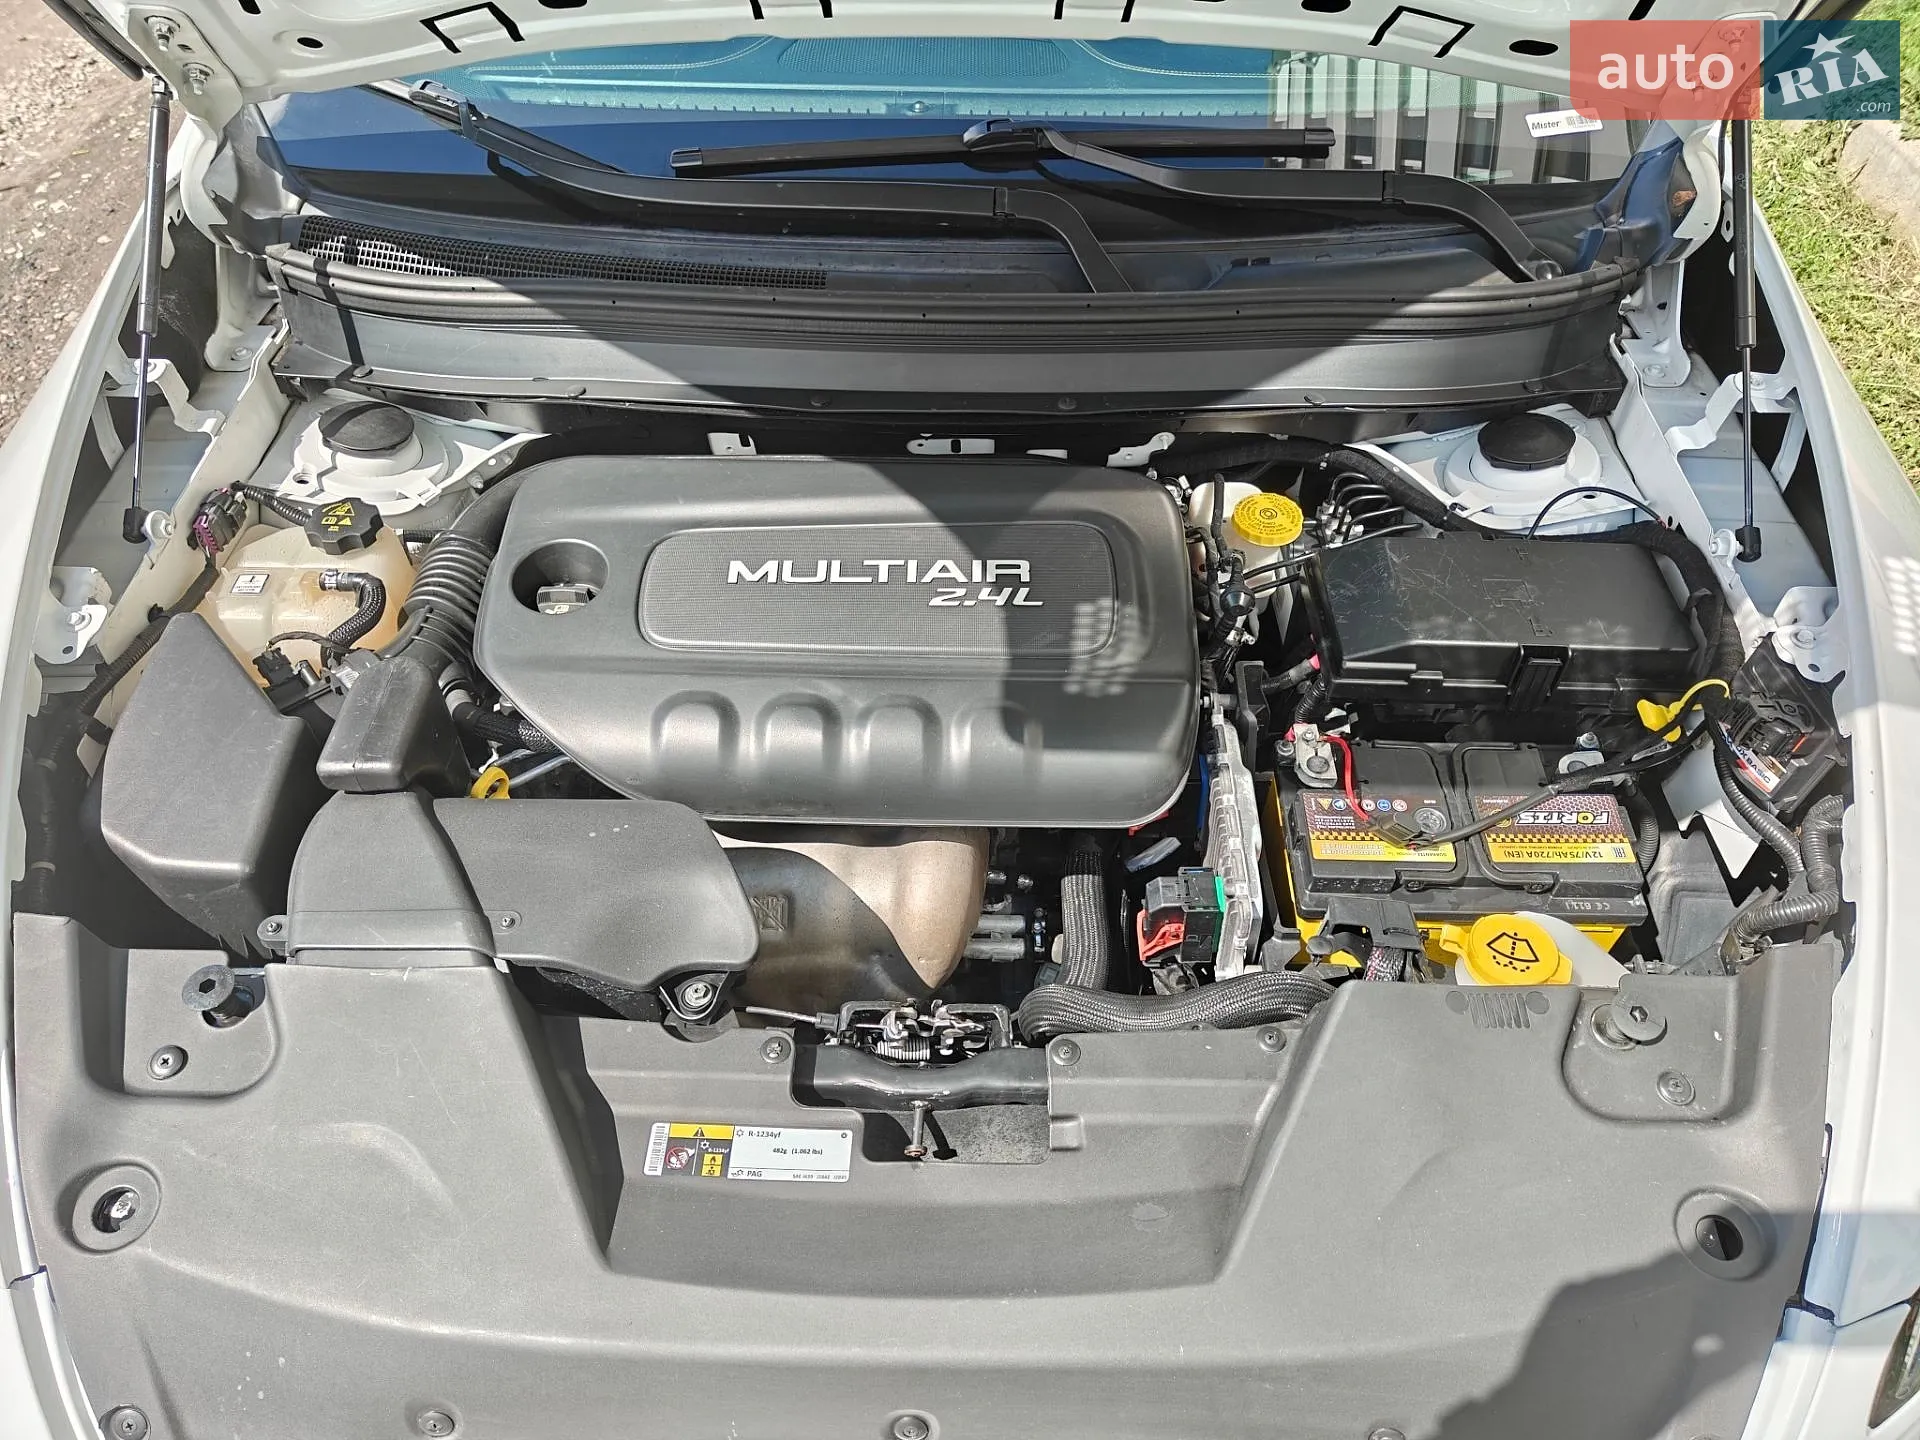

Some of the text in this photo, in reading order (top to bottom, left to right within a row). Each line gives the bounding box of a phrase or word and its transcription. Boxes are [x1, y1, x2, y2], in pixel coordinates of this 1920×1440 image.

[1531, 119, 1561, 132] Mister
[727, 558, 1032, 584] MULTIAIR
[928, 587, 1044, 607] 2.4L
[1745, 757, 1771, 784] BASIC
[1516, 810, 1610, 826] FORTIS
[1503, 850, 1524, 859] (EN)
[748, 1130, 781, 1139] R-1234yf
